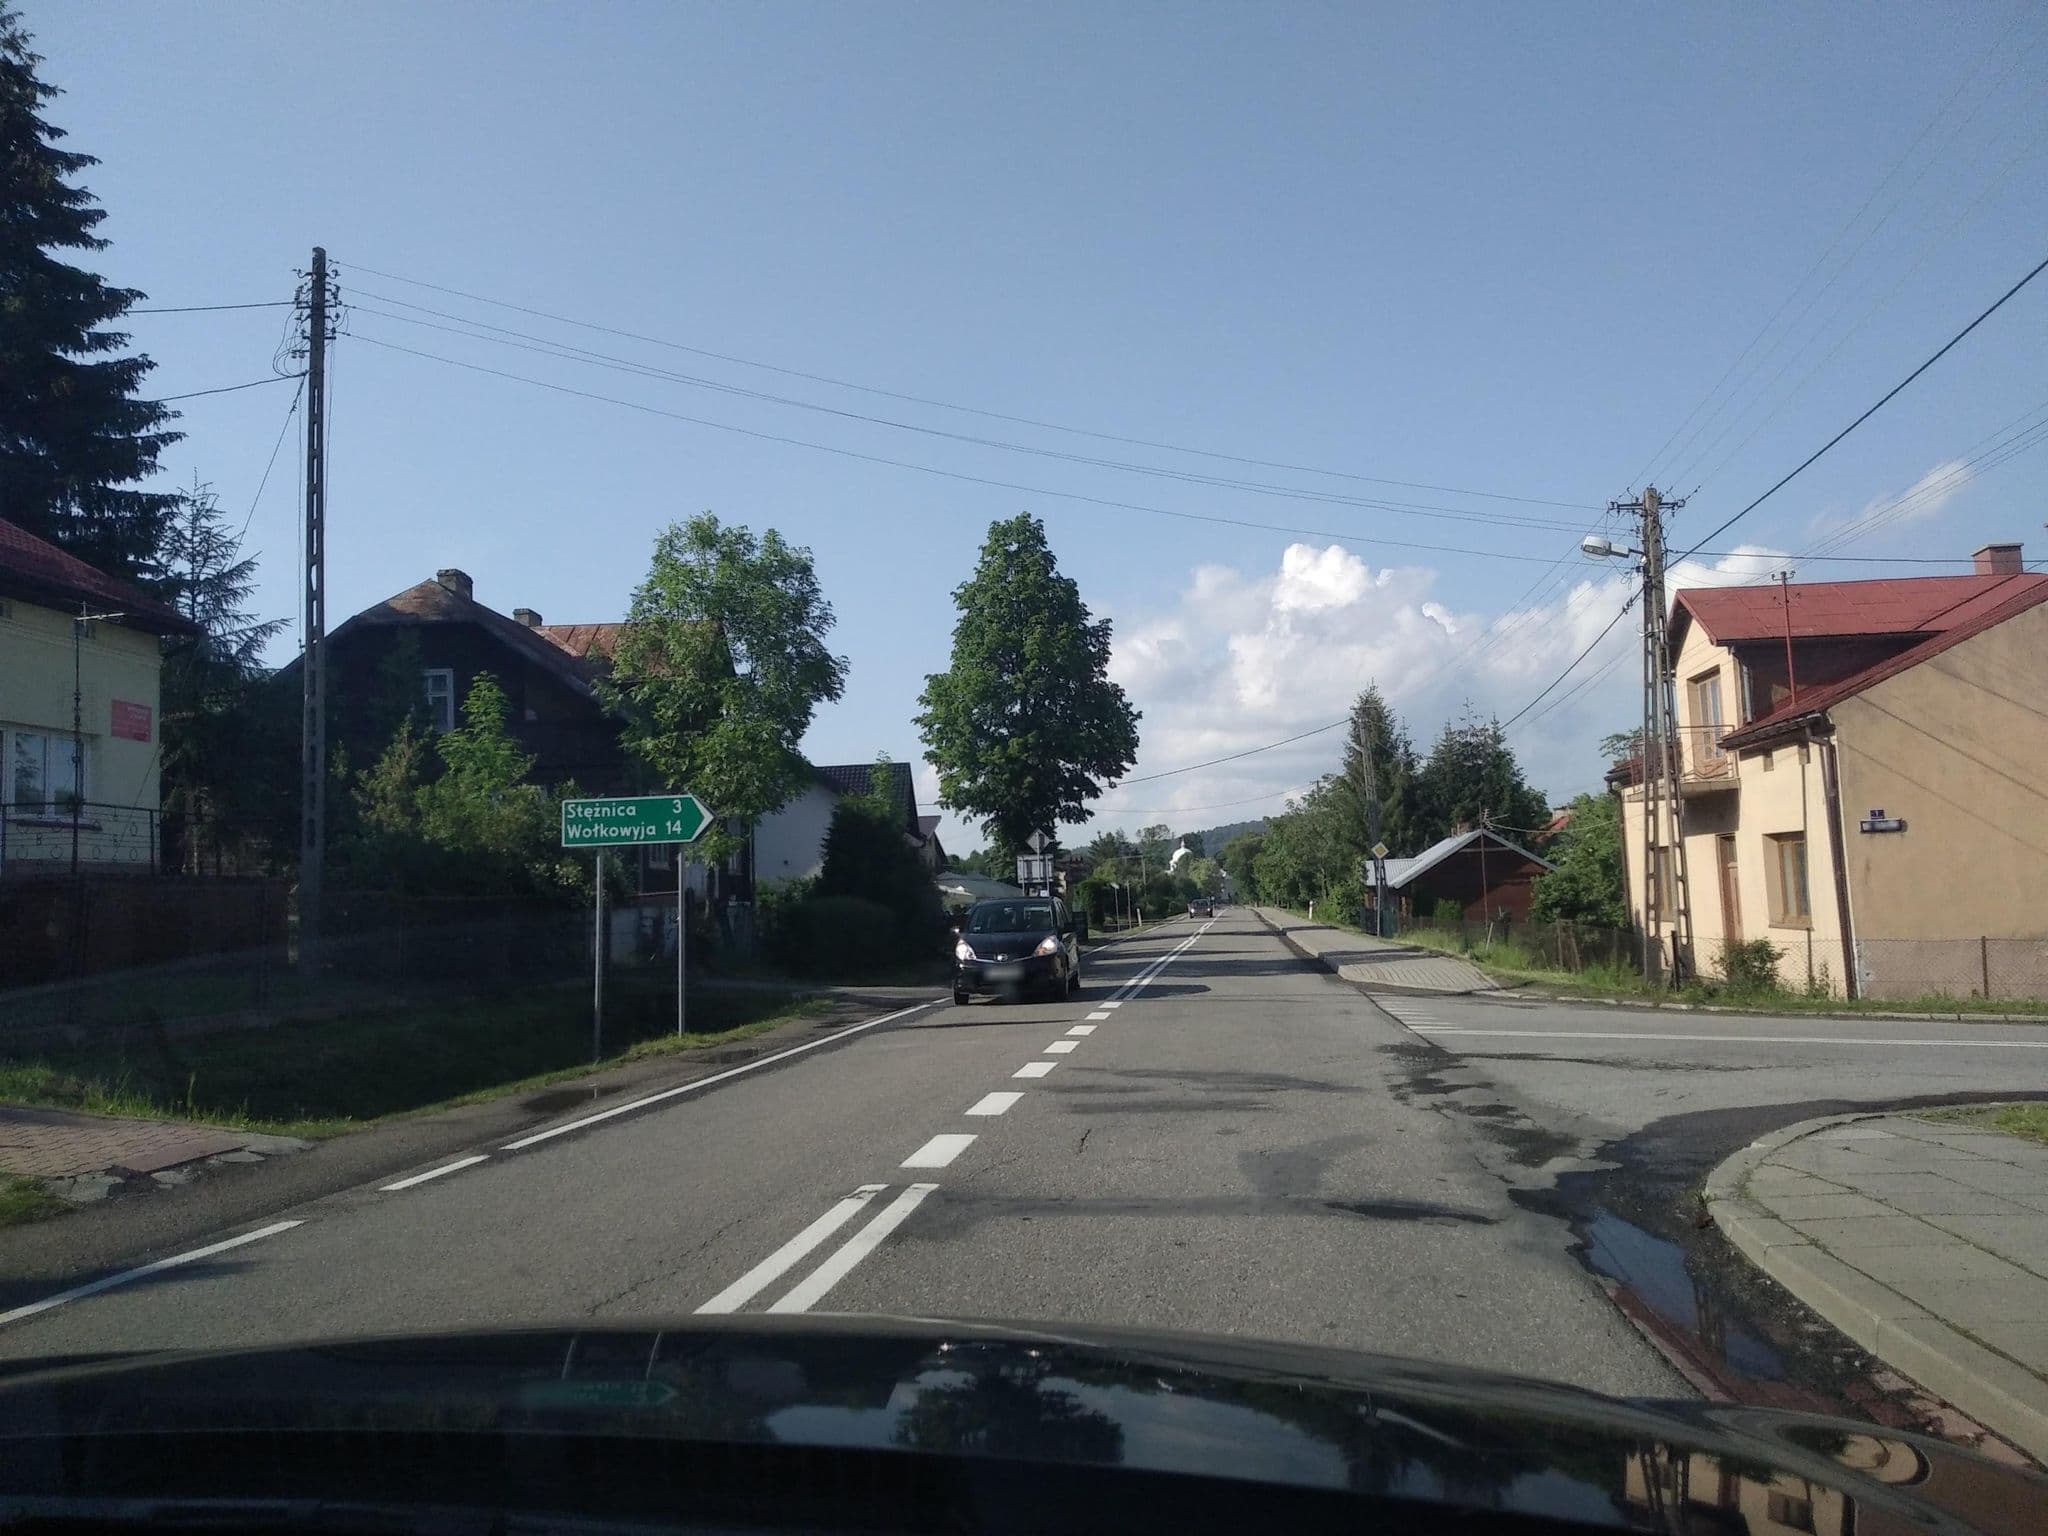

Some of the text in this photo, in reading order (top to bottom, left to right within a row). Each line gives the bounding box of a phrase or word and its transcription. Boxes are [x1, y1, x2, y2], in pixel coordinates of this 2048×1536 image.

[567, 800, 682, 821] Stężnica 3
[567, 820, 682, 840] Wołkowyja 14
